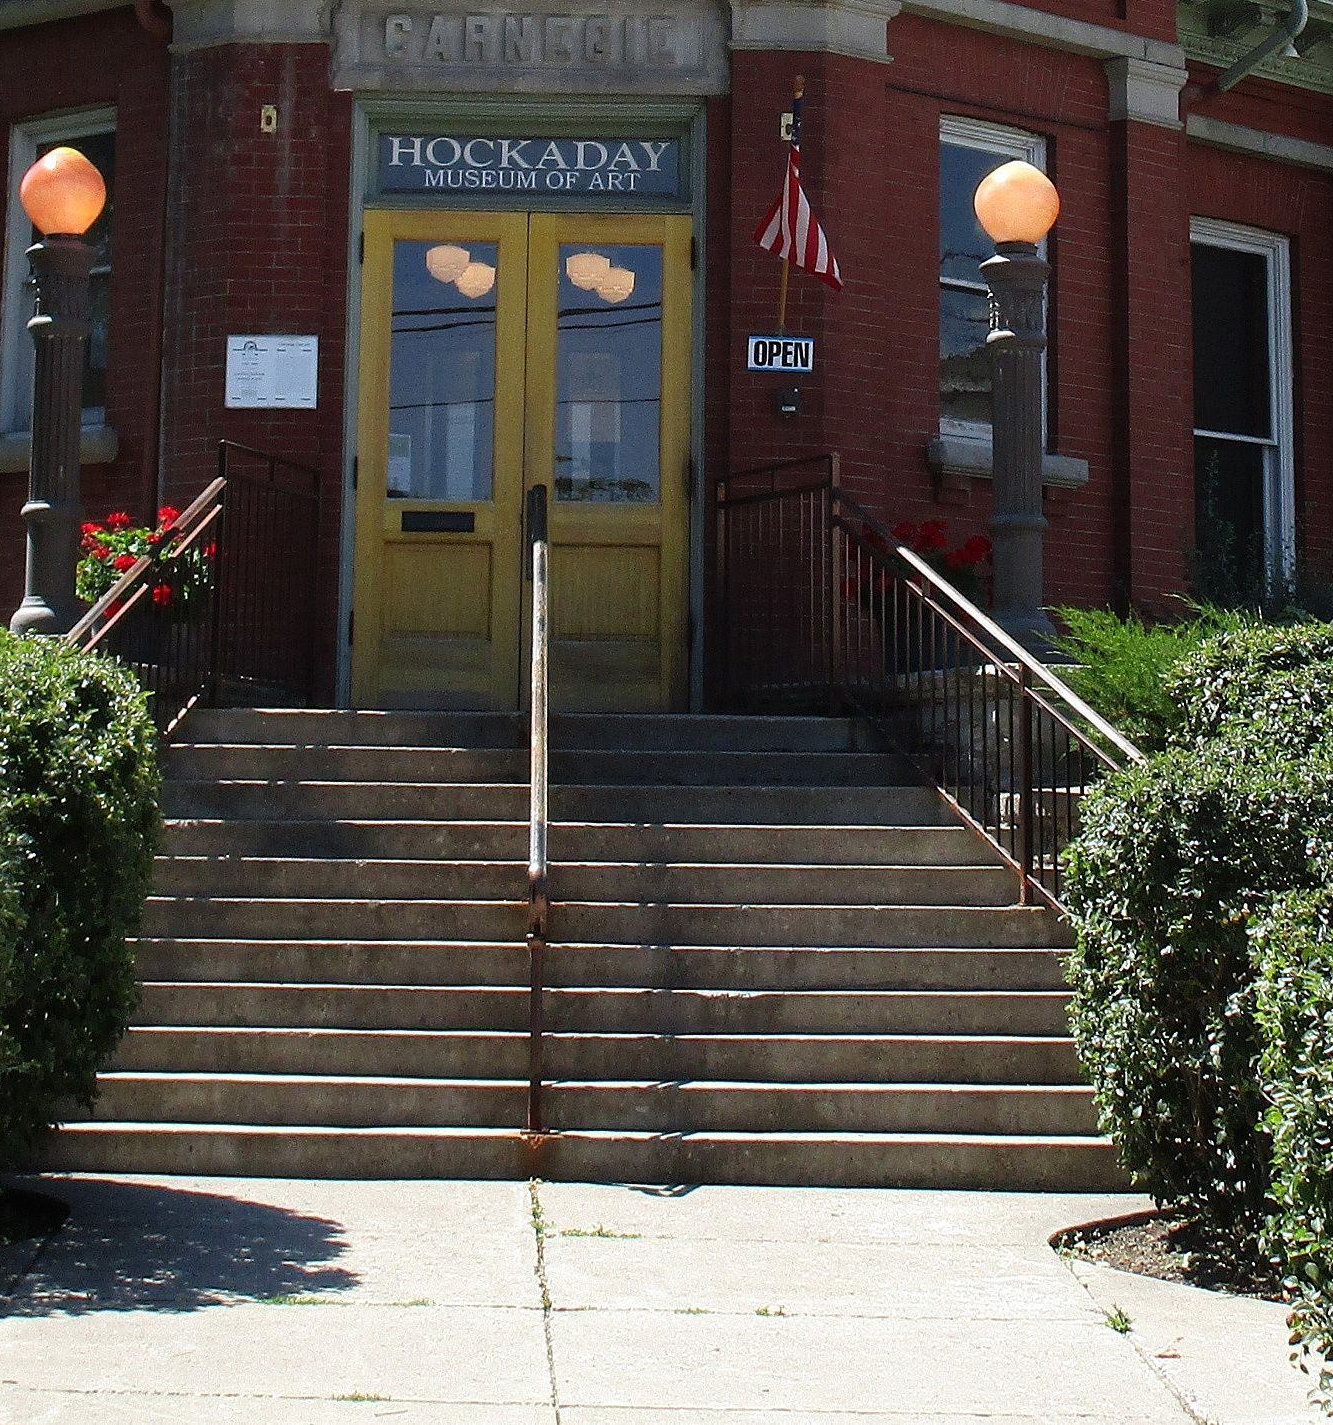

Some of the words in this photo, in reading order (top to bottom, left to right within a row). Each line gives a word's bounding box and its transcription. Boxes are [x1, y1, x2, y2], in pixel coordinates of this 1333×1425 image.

[383, 13, 680, 65] CARNEGIE
[388, 136, 671, 172] HOCKADAY
[424, 169, 537, 189] MUSEUM
[546, 171, 580, 190] OF
[588, 172, 641, 192] ART
[753, 340, 810, 368] OPEN
